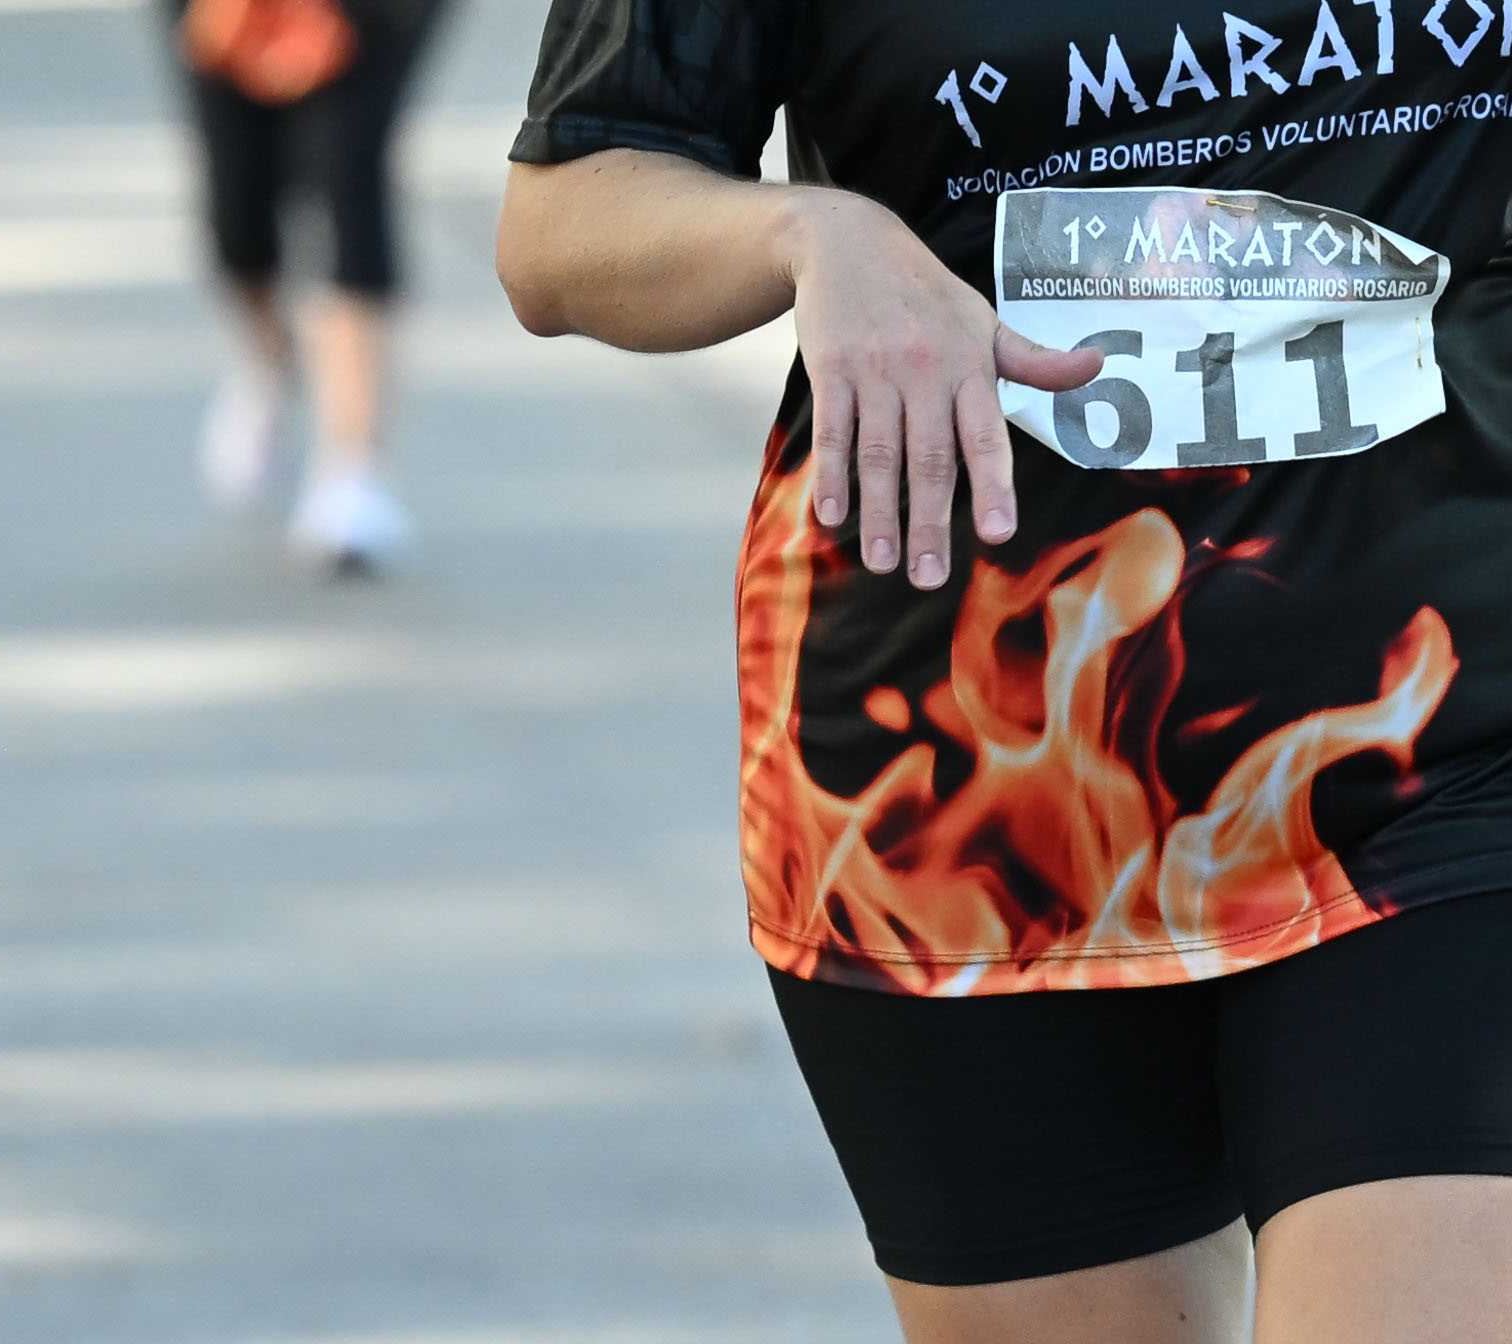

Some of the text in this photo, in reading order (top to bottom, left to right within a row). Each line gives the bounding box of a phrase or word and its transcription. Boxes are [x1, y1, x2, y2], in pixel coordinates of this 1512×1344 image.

[1089, 131, 1252, 173] BOMBEROS
[1123, 214, 1383, 267] MARATÓN
[1021, 273, 1428, 299] ASOCIACIÓN BOMBEROS VOLUNTARIOS ROSARIO
[1052, 320, 1379, 469] 611
